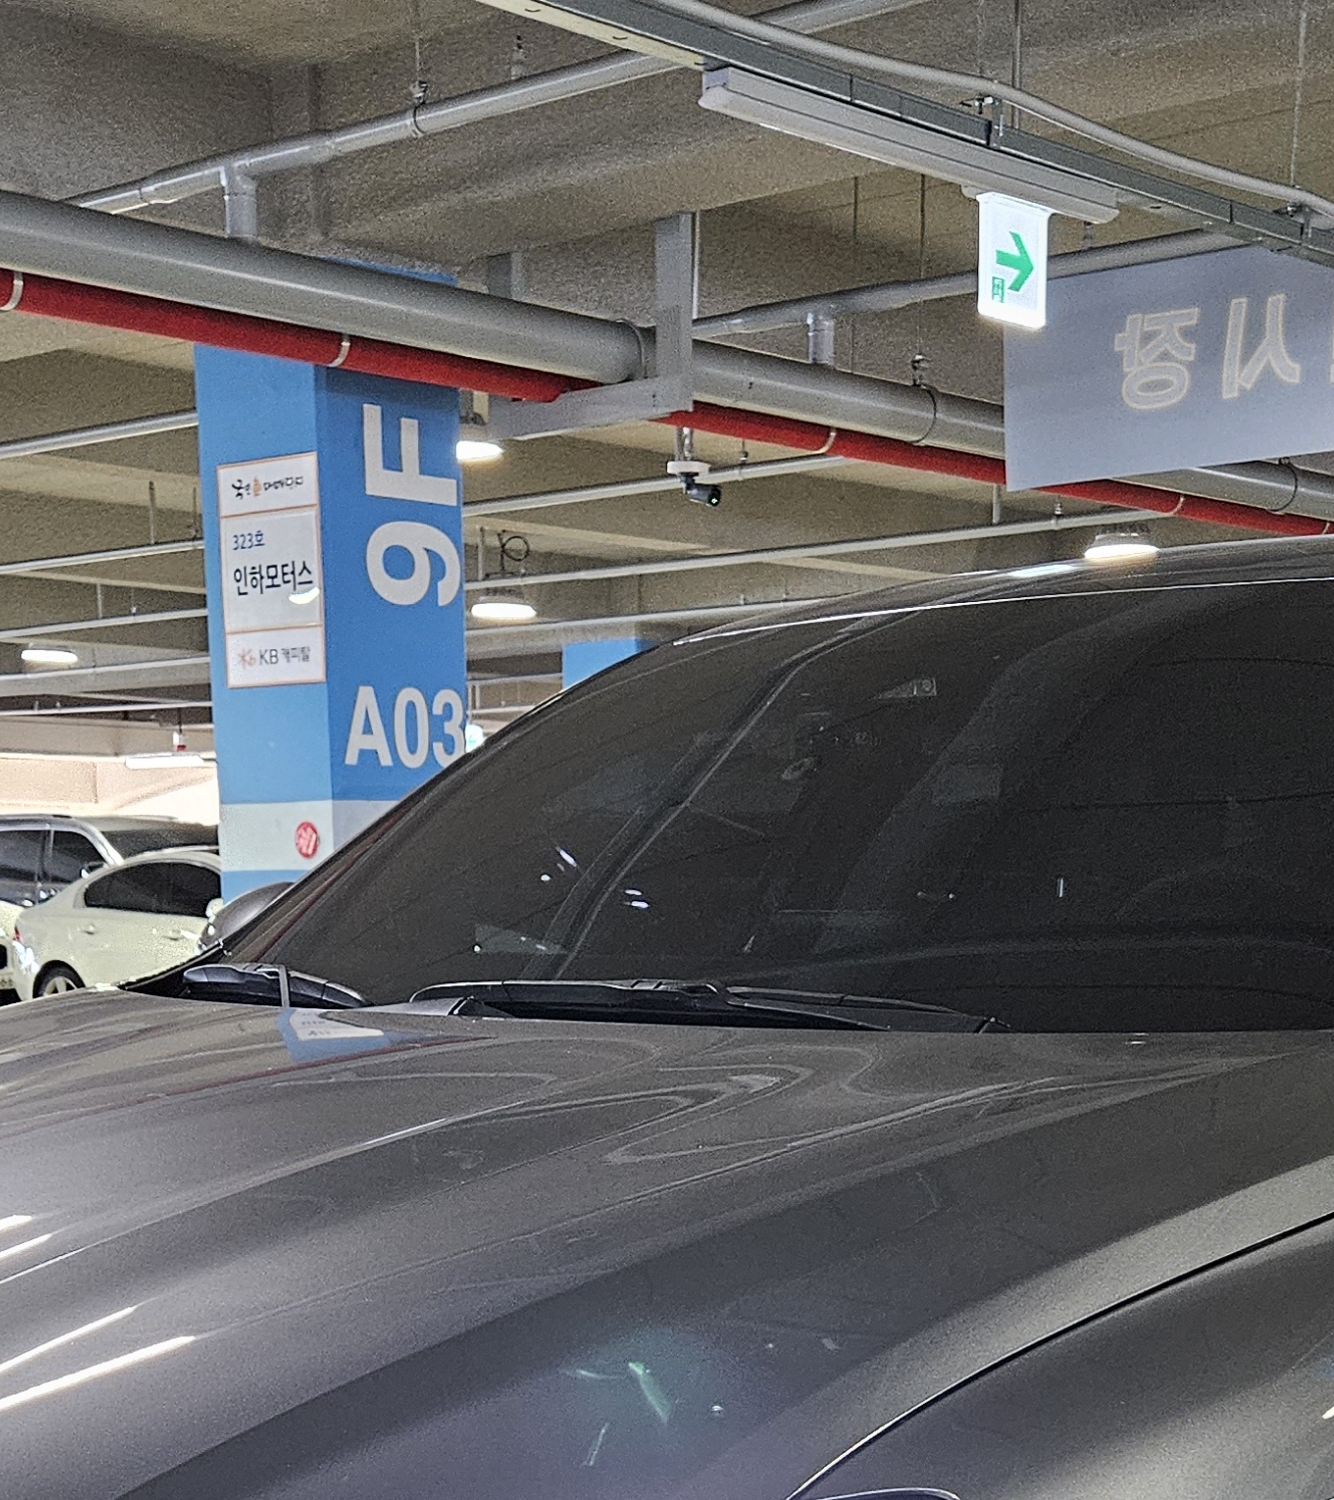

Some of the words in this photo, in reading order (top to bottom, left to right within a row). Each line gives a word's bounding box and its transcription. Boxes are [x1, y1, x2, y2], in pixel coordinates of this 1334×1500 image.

[362, 404, 461, 607] 9F
[231, 529, 266, 551] 323호
[233, 560, 314, 597] 인하모터스
[259, 648, 279, 666] KB
[344, 685, 465, 769] A03
